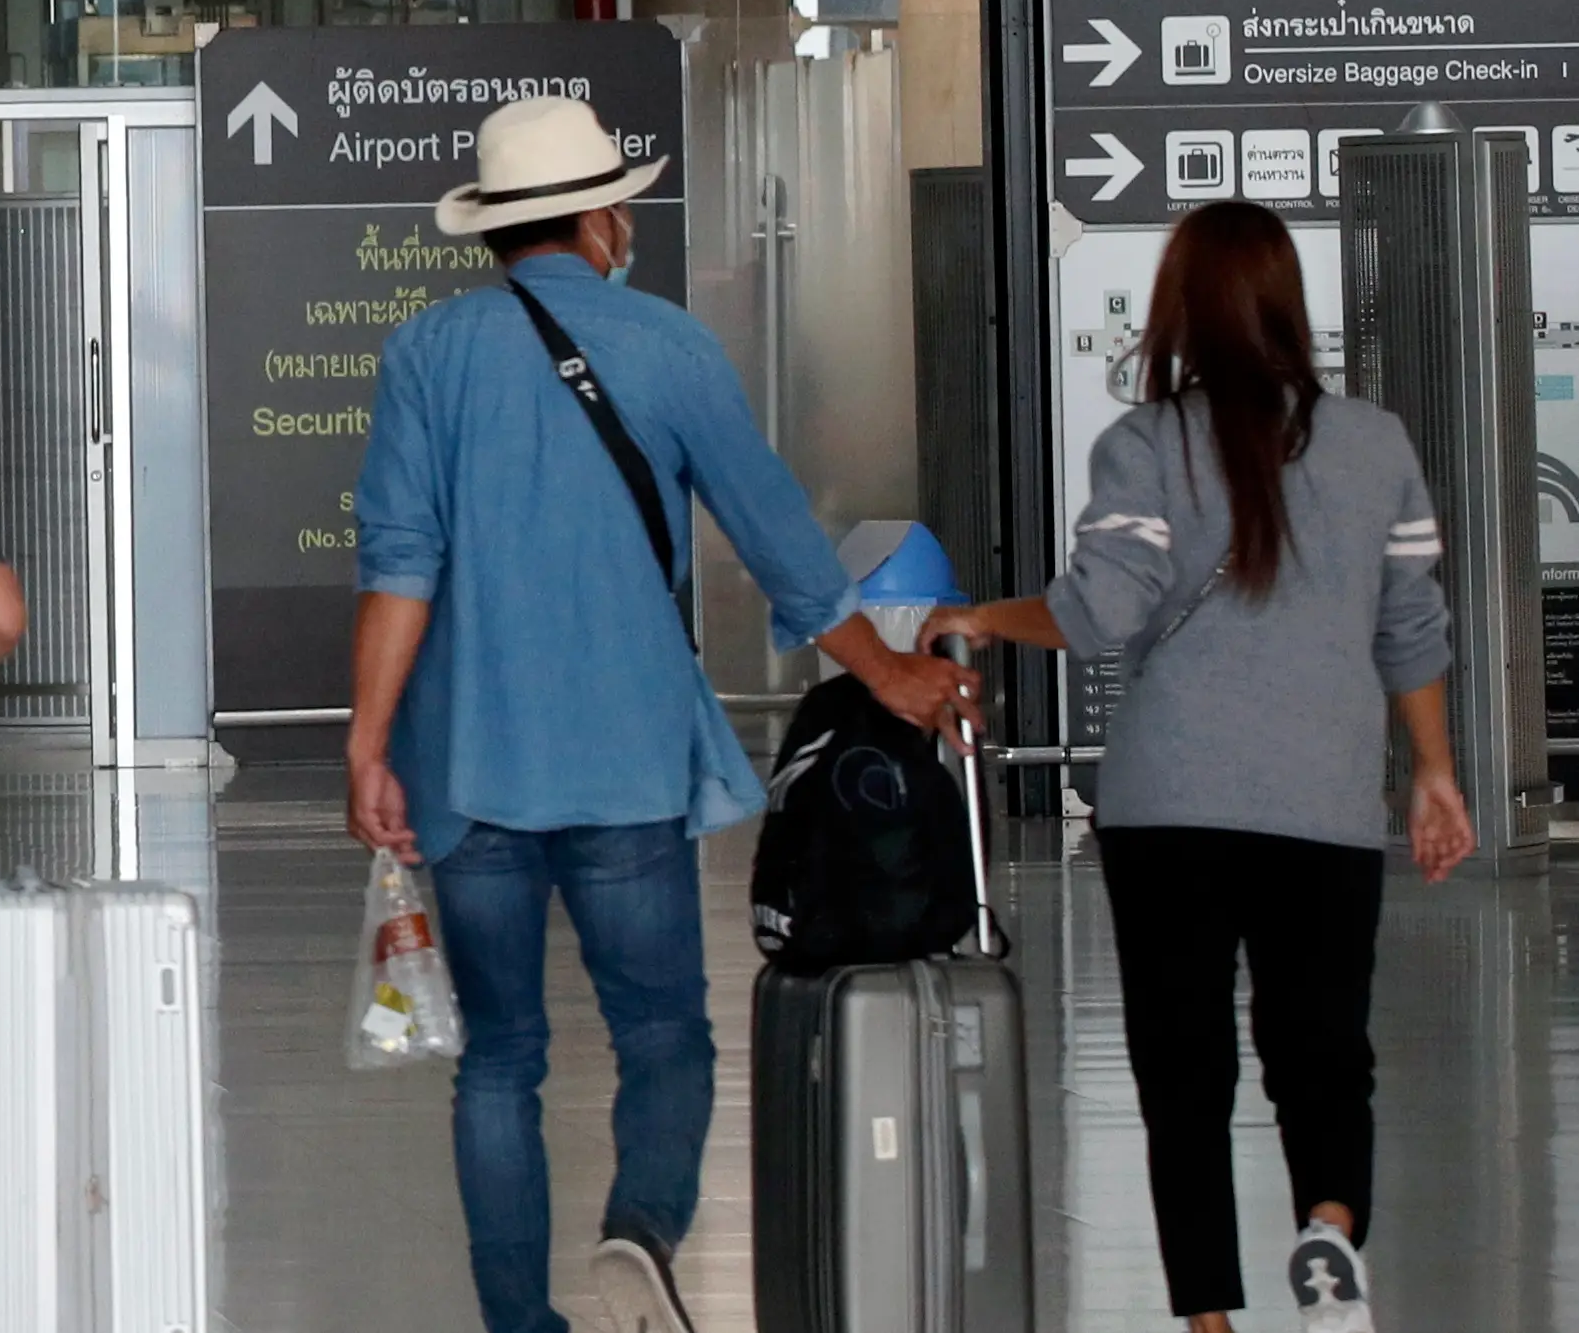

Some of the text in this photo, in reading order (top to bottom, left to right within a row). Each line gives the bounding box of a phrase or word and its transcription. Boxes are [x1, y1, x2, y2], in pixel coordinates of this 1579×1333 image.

[1244, 62, 1338, 84] Oversize
[1344, 61, 1439, 87] Baggage
[1445, 59, 1539, 82] Check-in
[329, 131, 441, 169] Airport
[1274, 200, 1314, 209] CONTROL
[1112, 298, 1122, 309] C
[264, 349, 382, 383] (หมายเล
